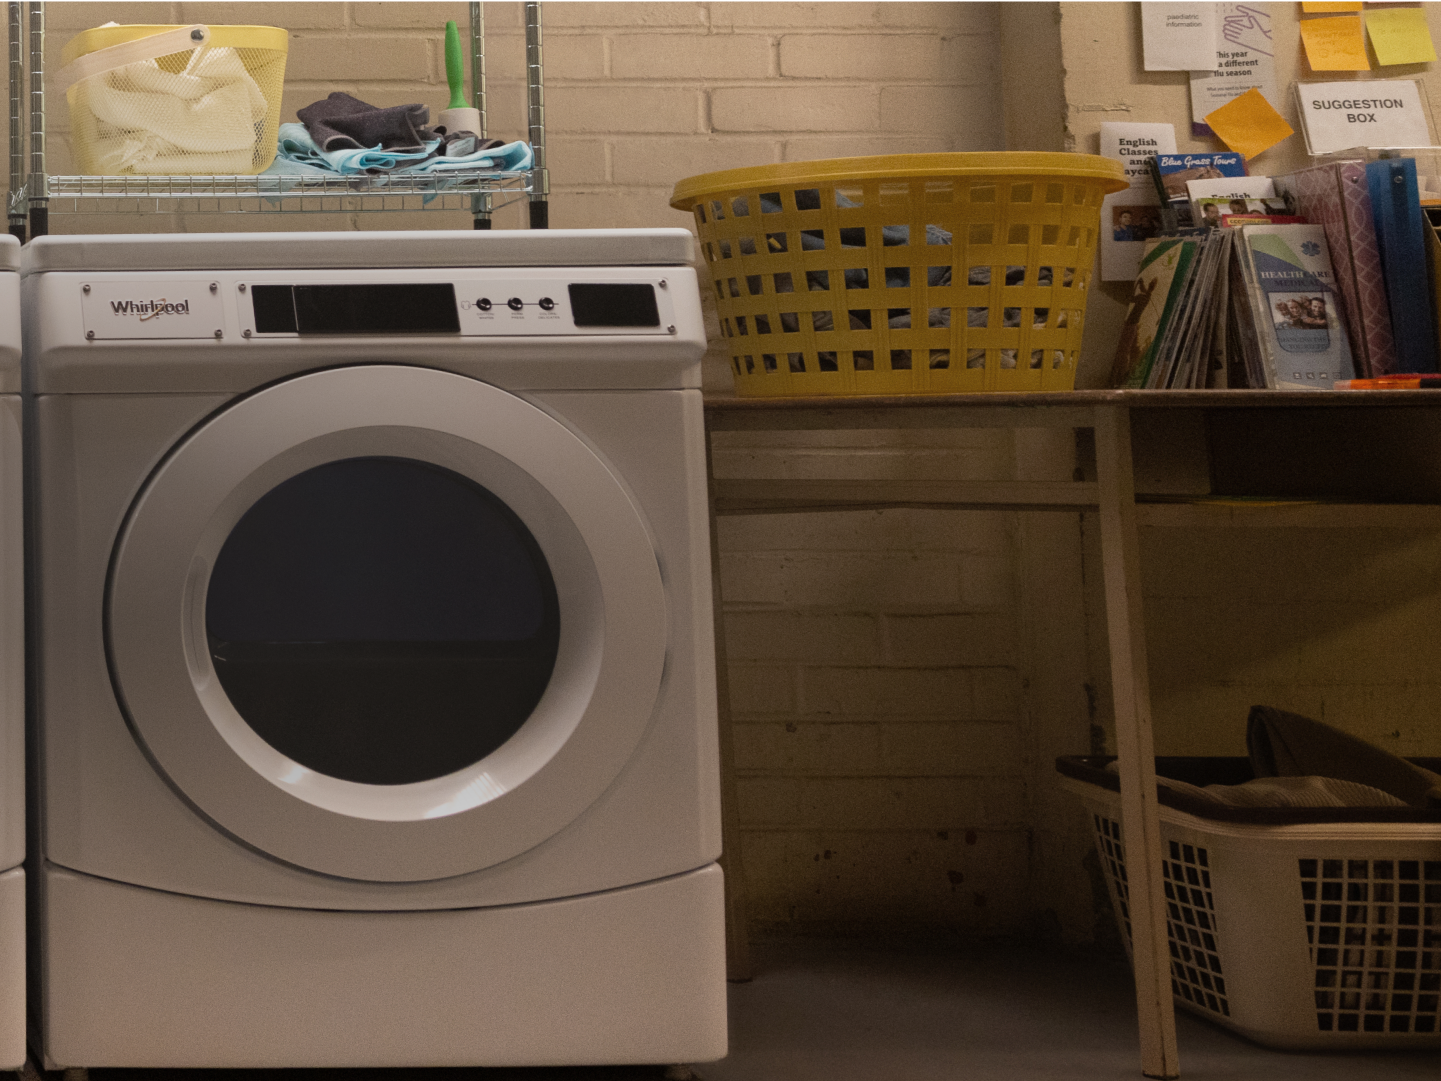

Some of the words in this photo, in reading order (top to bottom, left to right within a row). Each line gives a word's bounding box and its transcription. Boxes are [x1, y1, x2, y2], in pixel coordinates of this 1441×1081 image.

[1167, 13, 1199, 21] paediatric
[1231, 51, 1248, 59] year
[1224, 59, 1259, 67] different
[1226, 69, 1252, 77] season
[1312, 98, 1404, 110] SUGGESTION
[1346, 113, 1377, 123] BOX
[1119, 138, 1157, 148] English
[1119, 147, 1158, 155] Classes
[1161, 156, 1182, 167] Blue
[1184, 155, 1211, 169] Grass
[1213, 155, 1237, 165] Tours
[1124, 169, 1150, 177] ayca
[110, 299, 190, 320] Whirlpool
